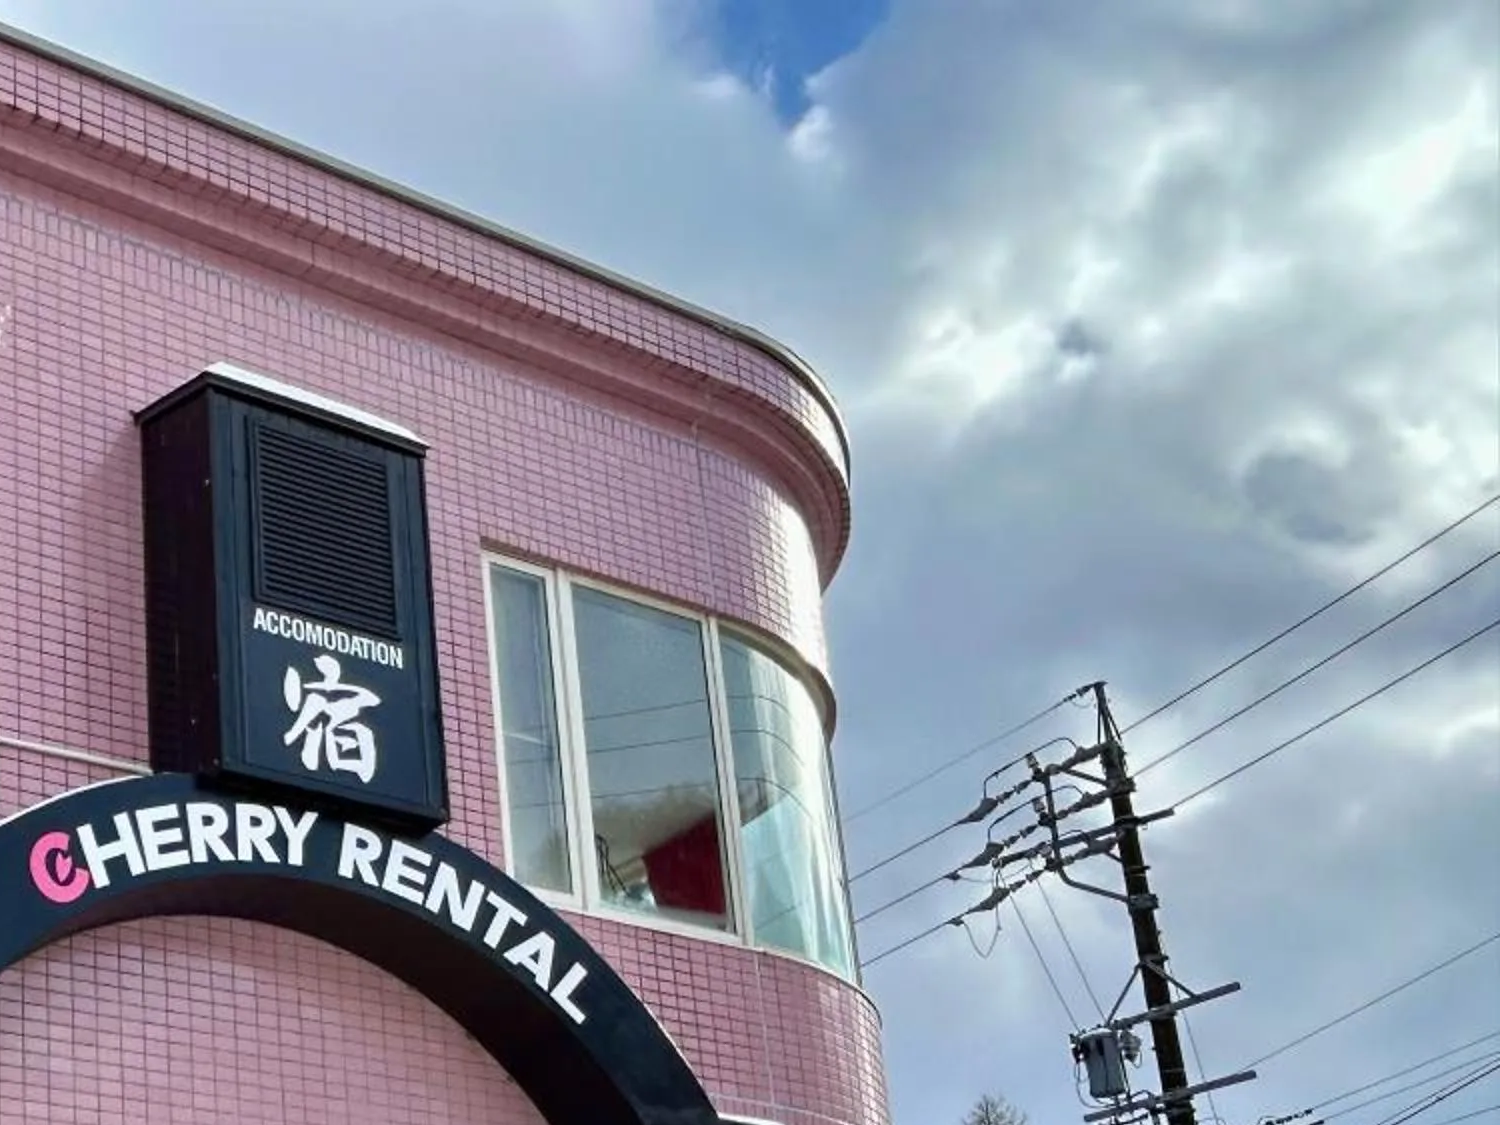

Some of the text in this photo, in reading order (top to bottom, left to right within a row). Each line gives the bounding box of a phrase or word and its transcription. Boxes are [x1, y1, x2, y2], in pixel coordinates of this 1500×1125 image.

[253, 607, 404, 670] ACCOMODATION
[283, 655, 382, 785] 宿
[29, 802, 589, 1026] CHERRY RENTAL
